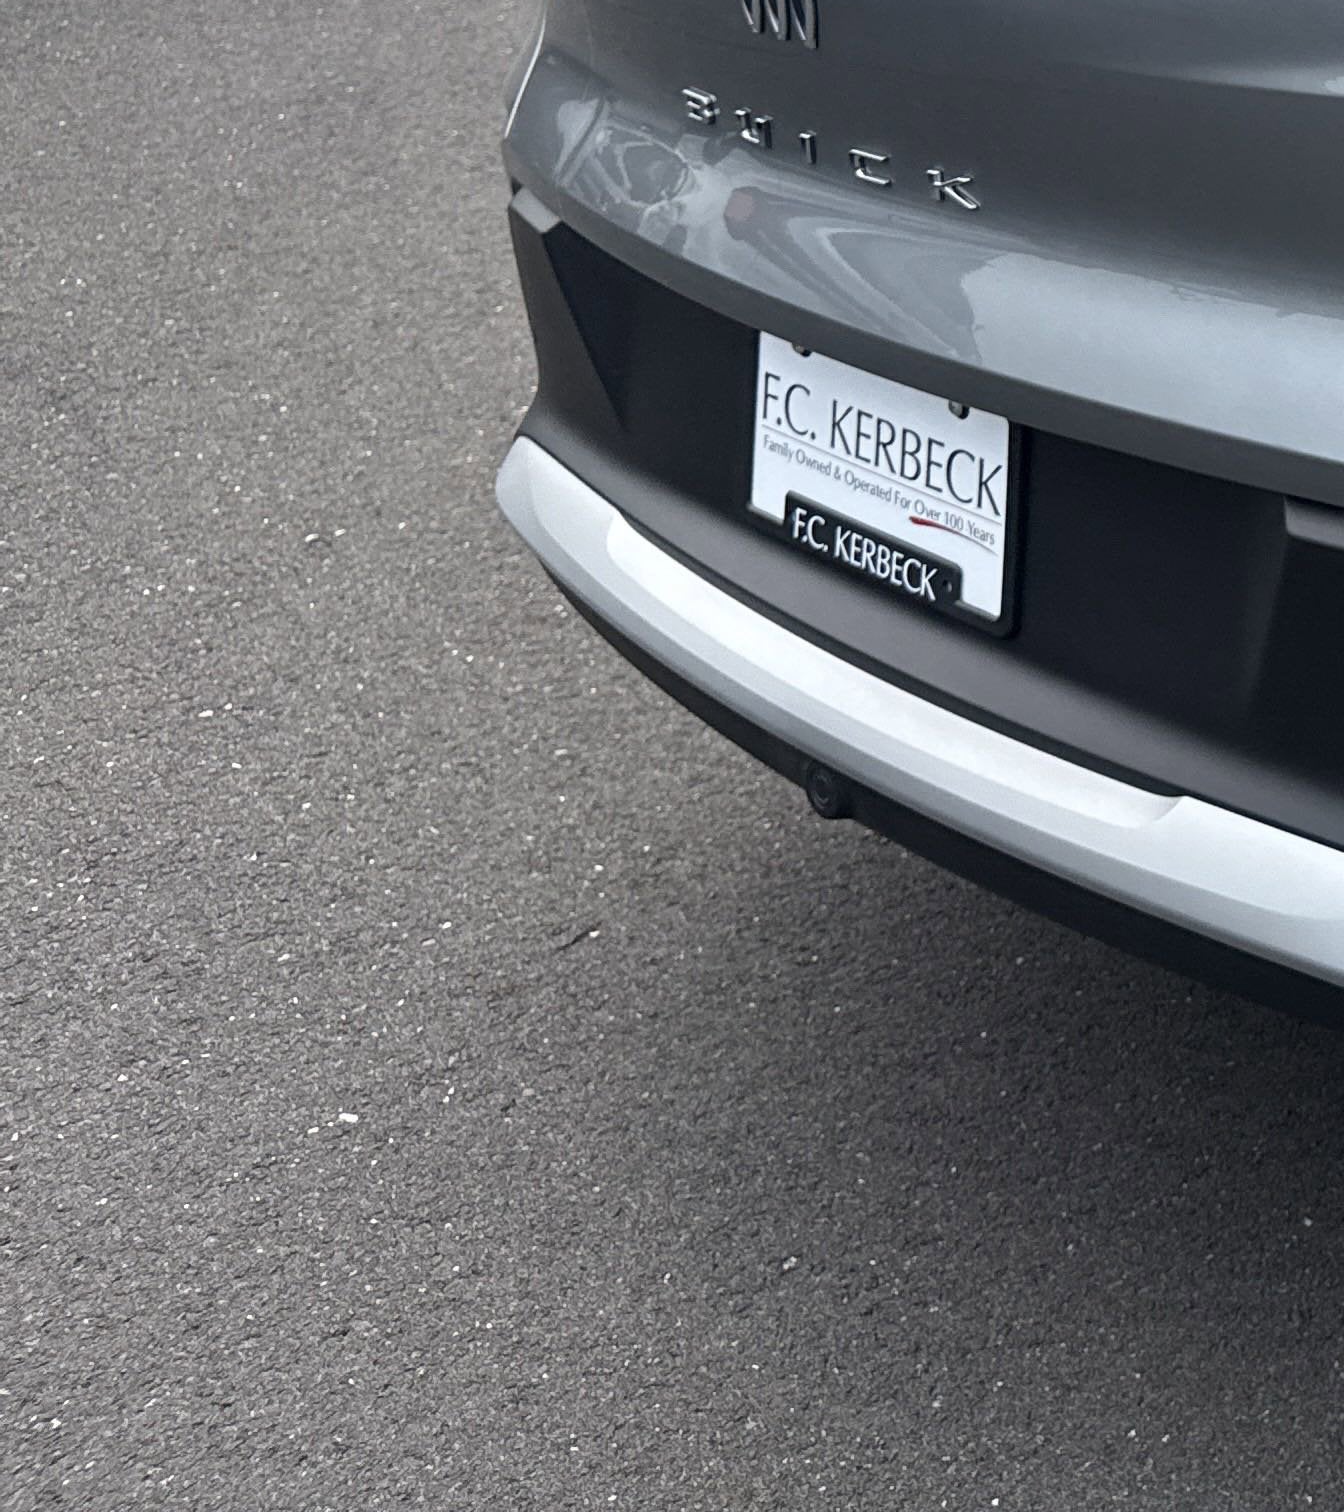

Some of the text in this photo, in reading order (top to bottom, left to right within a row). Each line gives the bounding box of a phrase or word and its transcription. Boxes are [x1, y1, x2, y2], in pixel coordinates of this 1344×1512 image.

[682, 86, 981, 210] BUICK
[762, 371, 1003, 516] F.C. KERBECK
[763, 434, 995, 546] Family Owned & Operated For Over 100 Years
[792, 507, 939, 601] F.C. KERBECK
